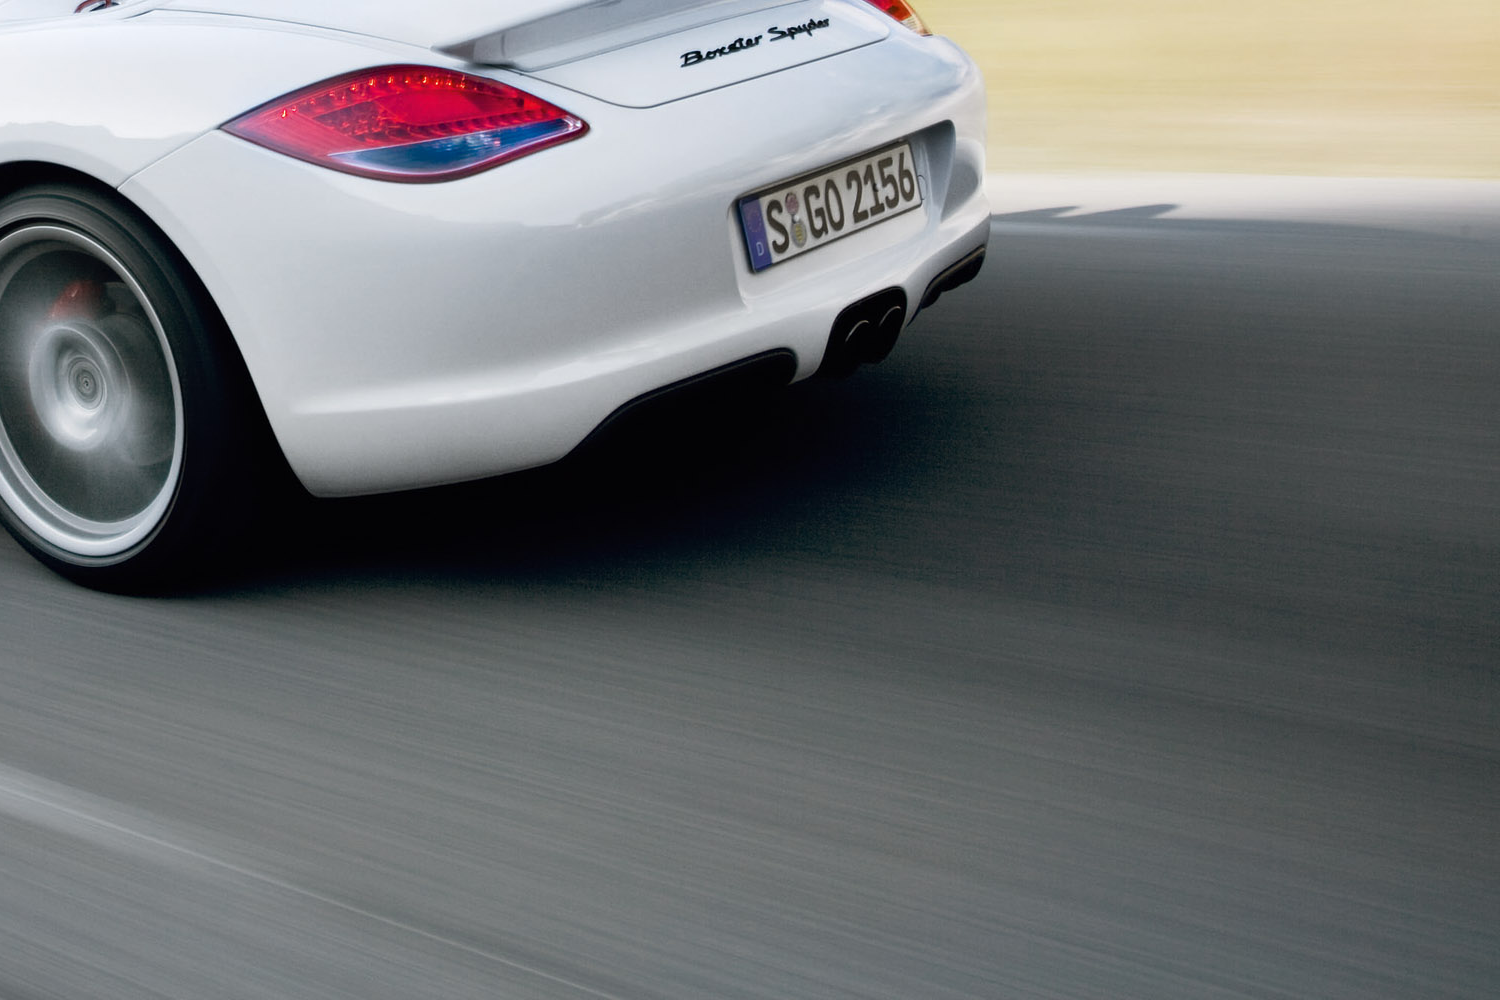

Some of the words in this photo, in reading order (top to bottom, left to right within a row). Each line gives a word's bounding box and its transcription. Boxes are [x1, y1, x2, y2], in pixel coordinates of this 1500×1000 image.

[680, 34, 763, 68] Boxster
[767, 18, 830, 42] Spyder
[766, 199, 790, 254] S
[804, 179, 845, 239] GO
[846, 152, 915, 224] 2156
[756, 241, 765, 257] D
